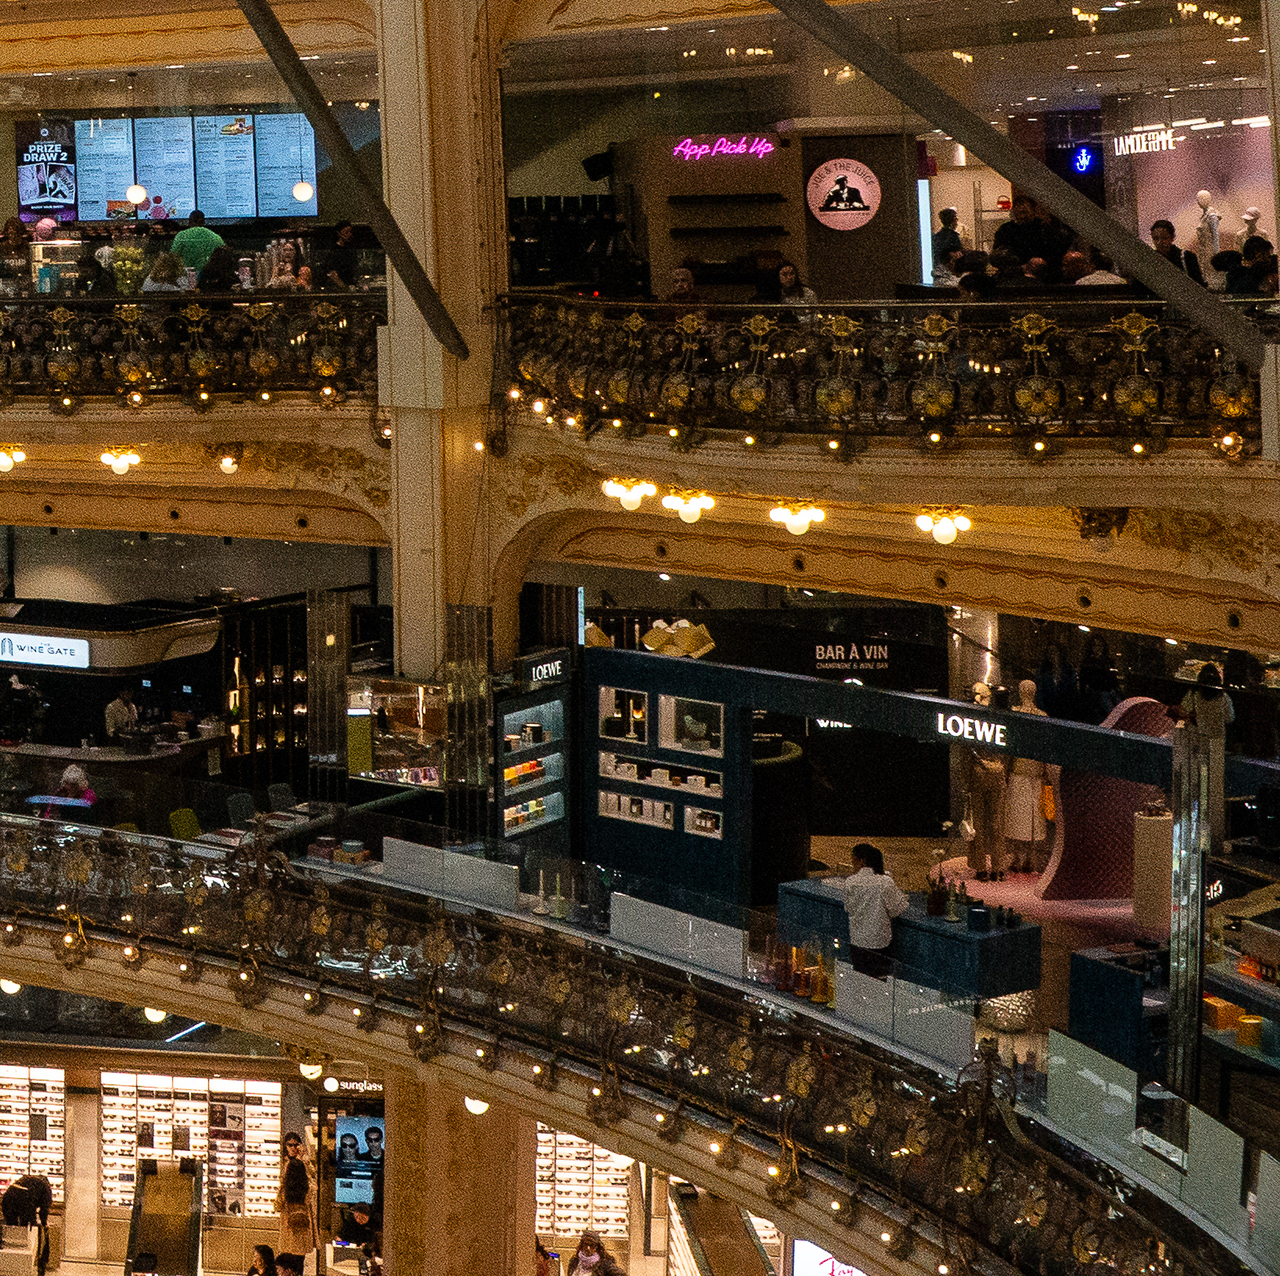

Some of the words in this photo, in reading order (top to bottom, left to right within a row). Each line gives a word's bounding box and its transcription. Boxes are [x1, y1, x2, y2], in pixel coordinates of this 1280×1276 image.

[29, 144, 62, 154] PRIZE
[673, 137, 711, 160] App
[710, 136, 747, 157] Pick
[748, 137, 775, 159] Up
[23, 153, 58, 162] DRAW
[60, 152, 68, 161] 2
[833, 163, 851, 171] THE
[16, 644, 44, 654] WINE
[47, 647, 75, 656] GATE
[815, 645, 845, 660] BAR
[849, 642, 860, 660] À
[863, 645, 889, 660] VIN
[532, 660, 562, 681] LOEWE
[937, 713, 1007, 746] LOEWE
[340, 1080, 383, 1092] sunglass
